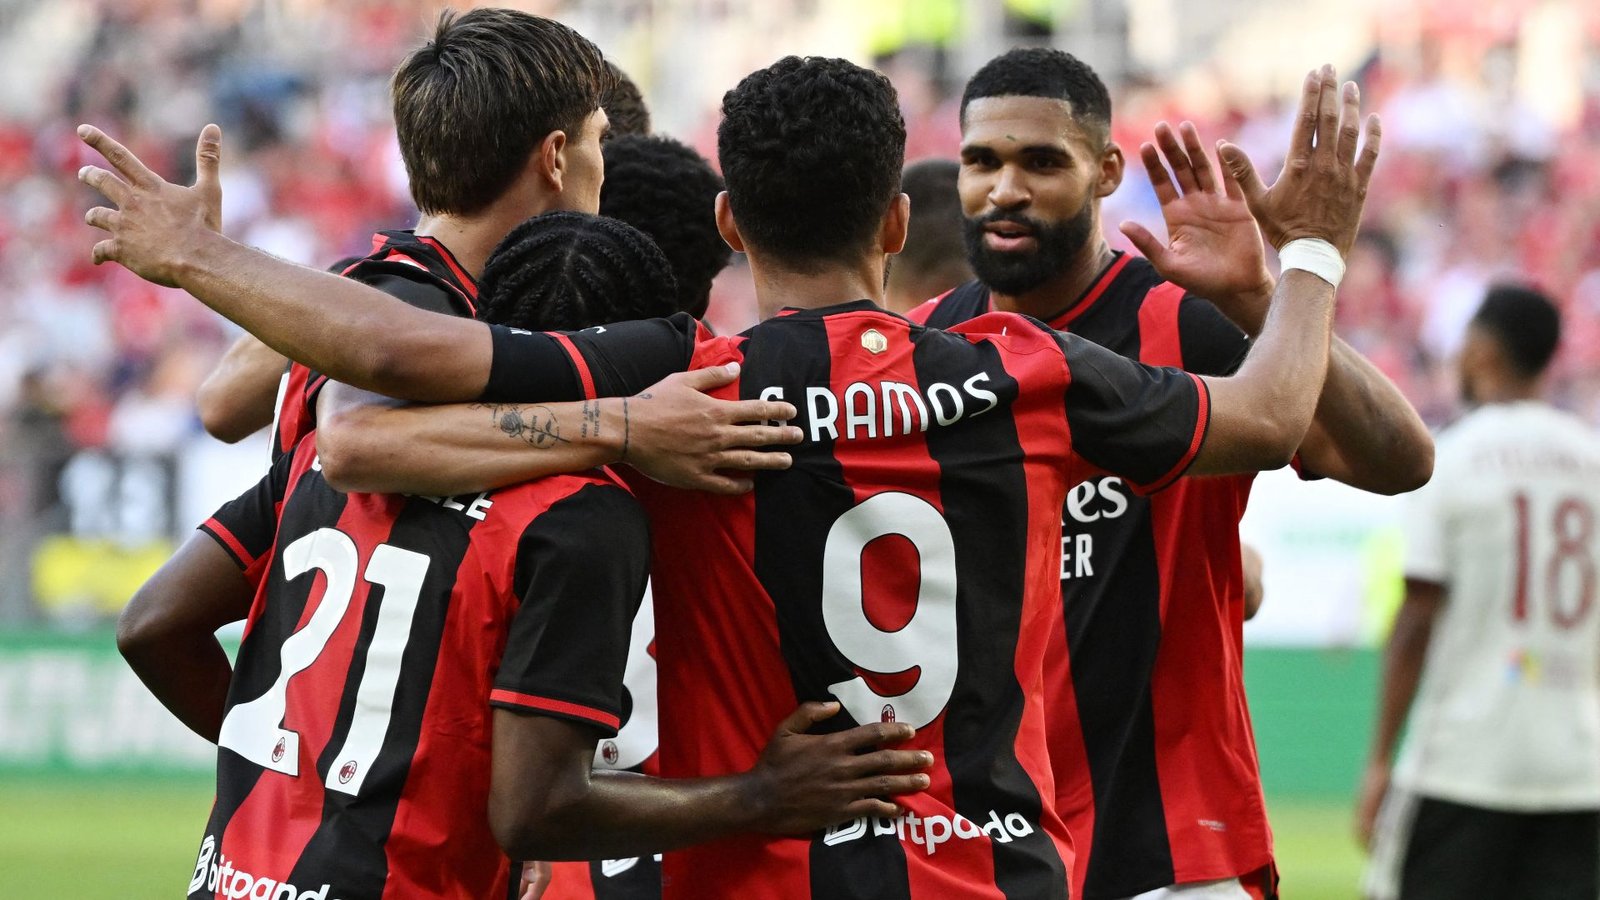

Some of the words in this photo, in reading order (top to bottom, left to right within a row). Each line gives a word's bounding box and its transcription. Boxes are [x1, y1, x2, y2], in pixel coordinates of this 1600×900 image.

[805, 371, 998, 442] RAMOS
[821, 491, 959, 730] 9
[1507, 491, 1598, 631] 18
[218, 527, 431, 797] 21
